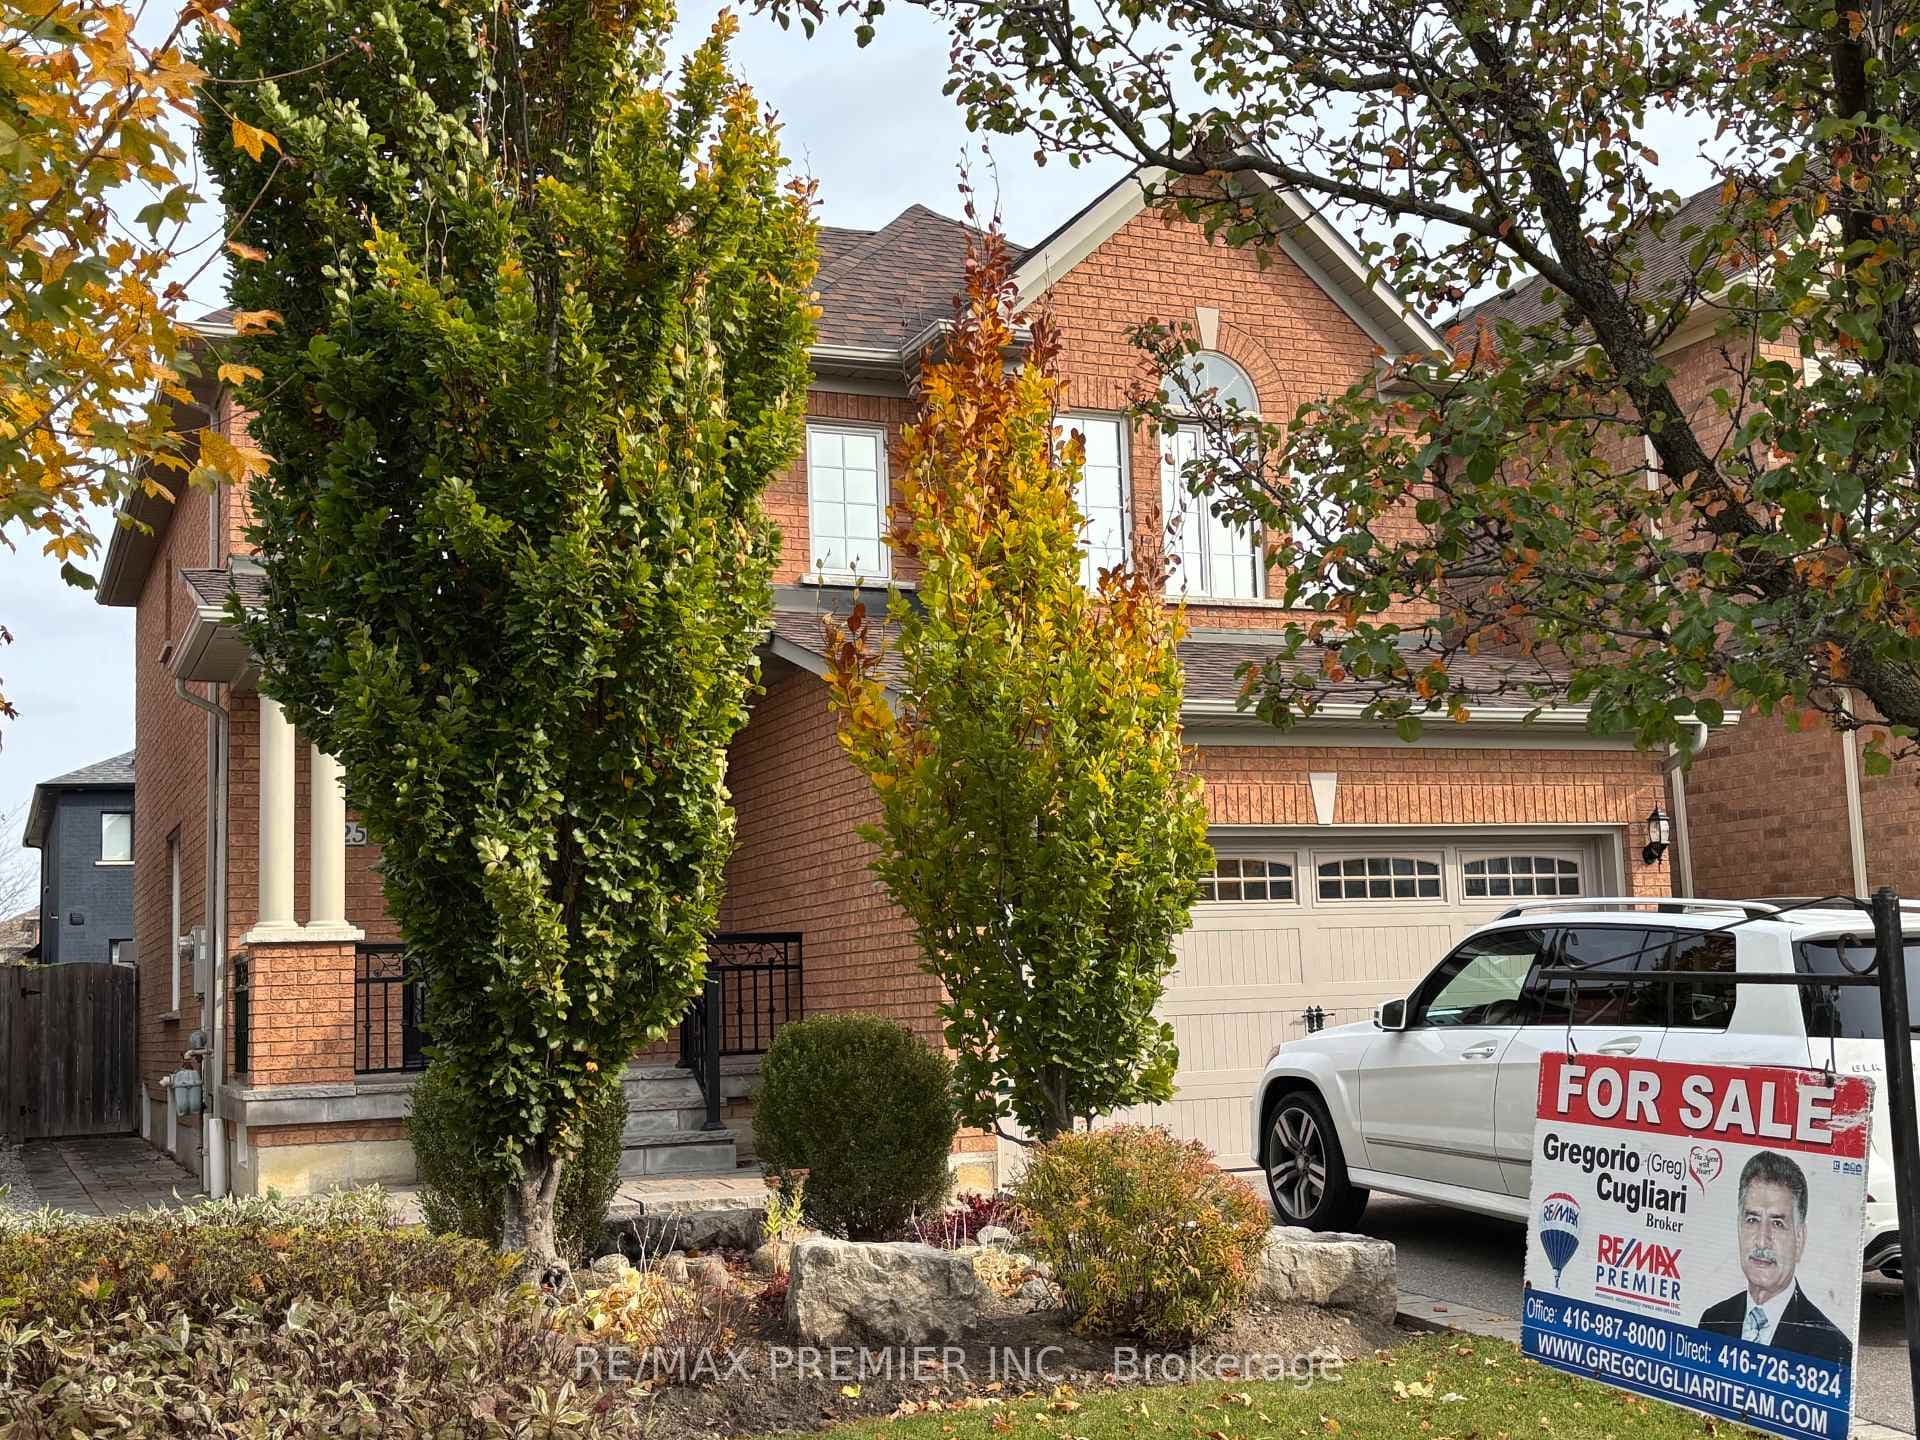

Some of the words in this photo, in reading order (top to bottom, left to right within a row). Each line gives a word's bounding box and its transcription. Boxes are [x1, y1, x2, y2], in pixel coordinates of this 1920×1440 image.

[1556, 1064, 1662, 1125] FOR
[1679, 1075, 1835, 1144] SALE
[1543, 1133, 1640, 1173] Gregorio
[1646, 1151, 1687, 1181] (Greg)
[1543, 1202, 1579, 1229] RE/MAX
[1596, 1172, 1687, 1214] Cugliari
[1646, 1212, 1684, 1233] Broker
[1597, 1233, 1682, 1280] RE/MAX
[1595, 1264, 1681, 1301] PREMIER
[1526, 1297, 1558, 1325] Office:
[1562, 1306, 1666, 1351] 416-987-8000
[1675, 1333, 1712, 1365] Direct:
[1717, 1344, 1841, 1399] 416-726-3824
[1537, 1333, 1828, 1434] WWW.GREGCUGLIARITEAM.COM
